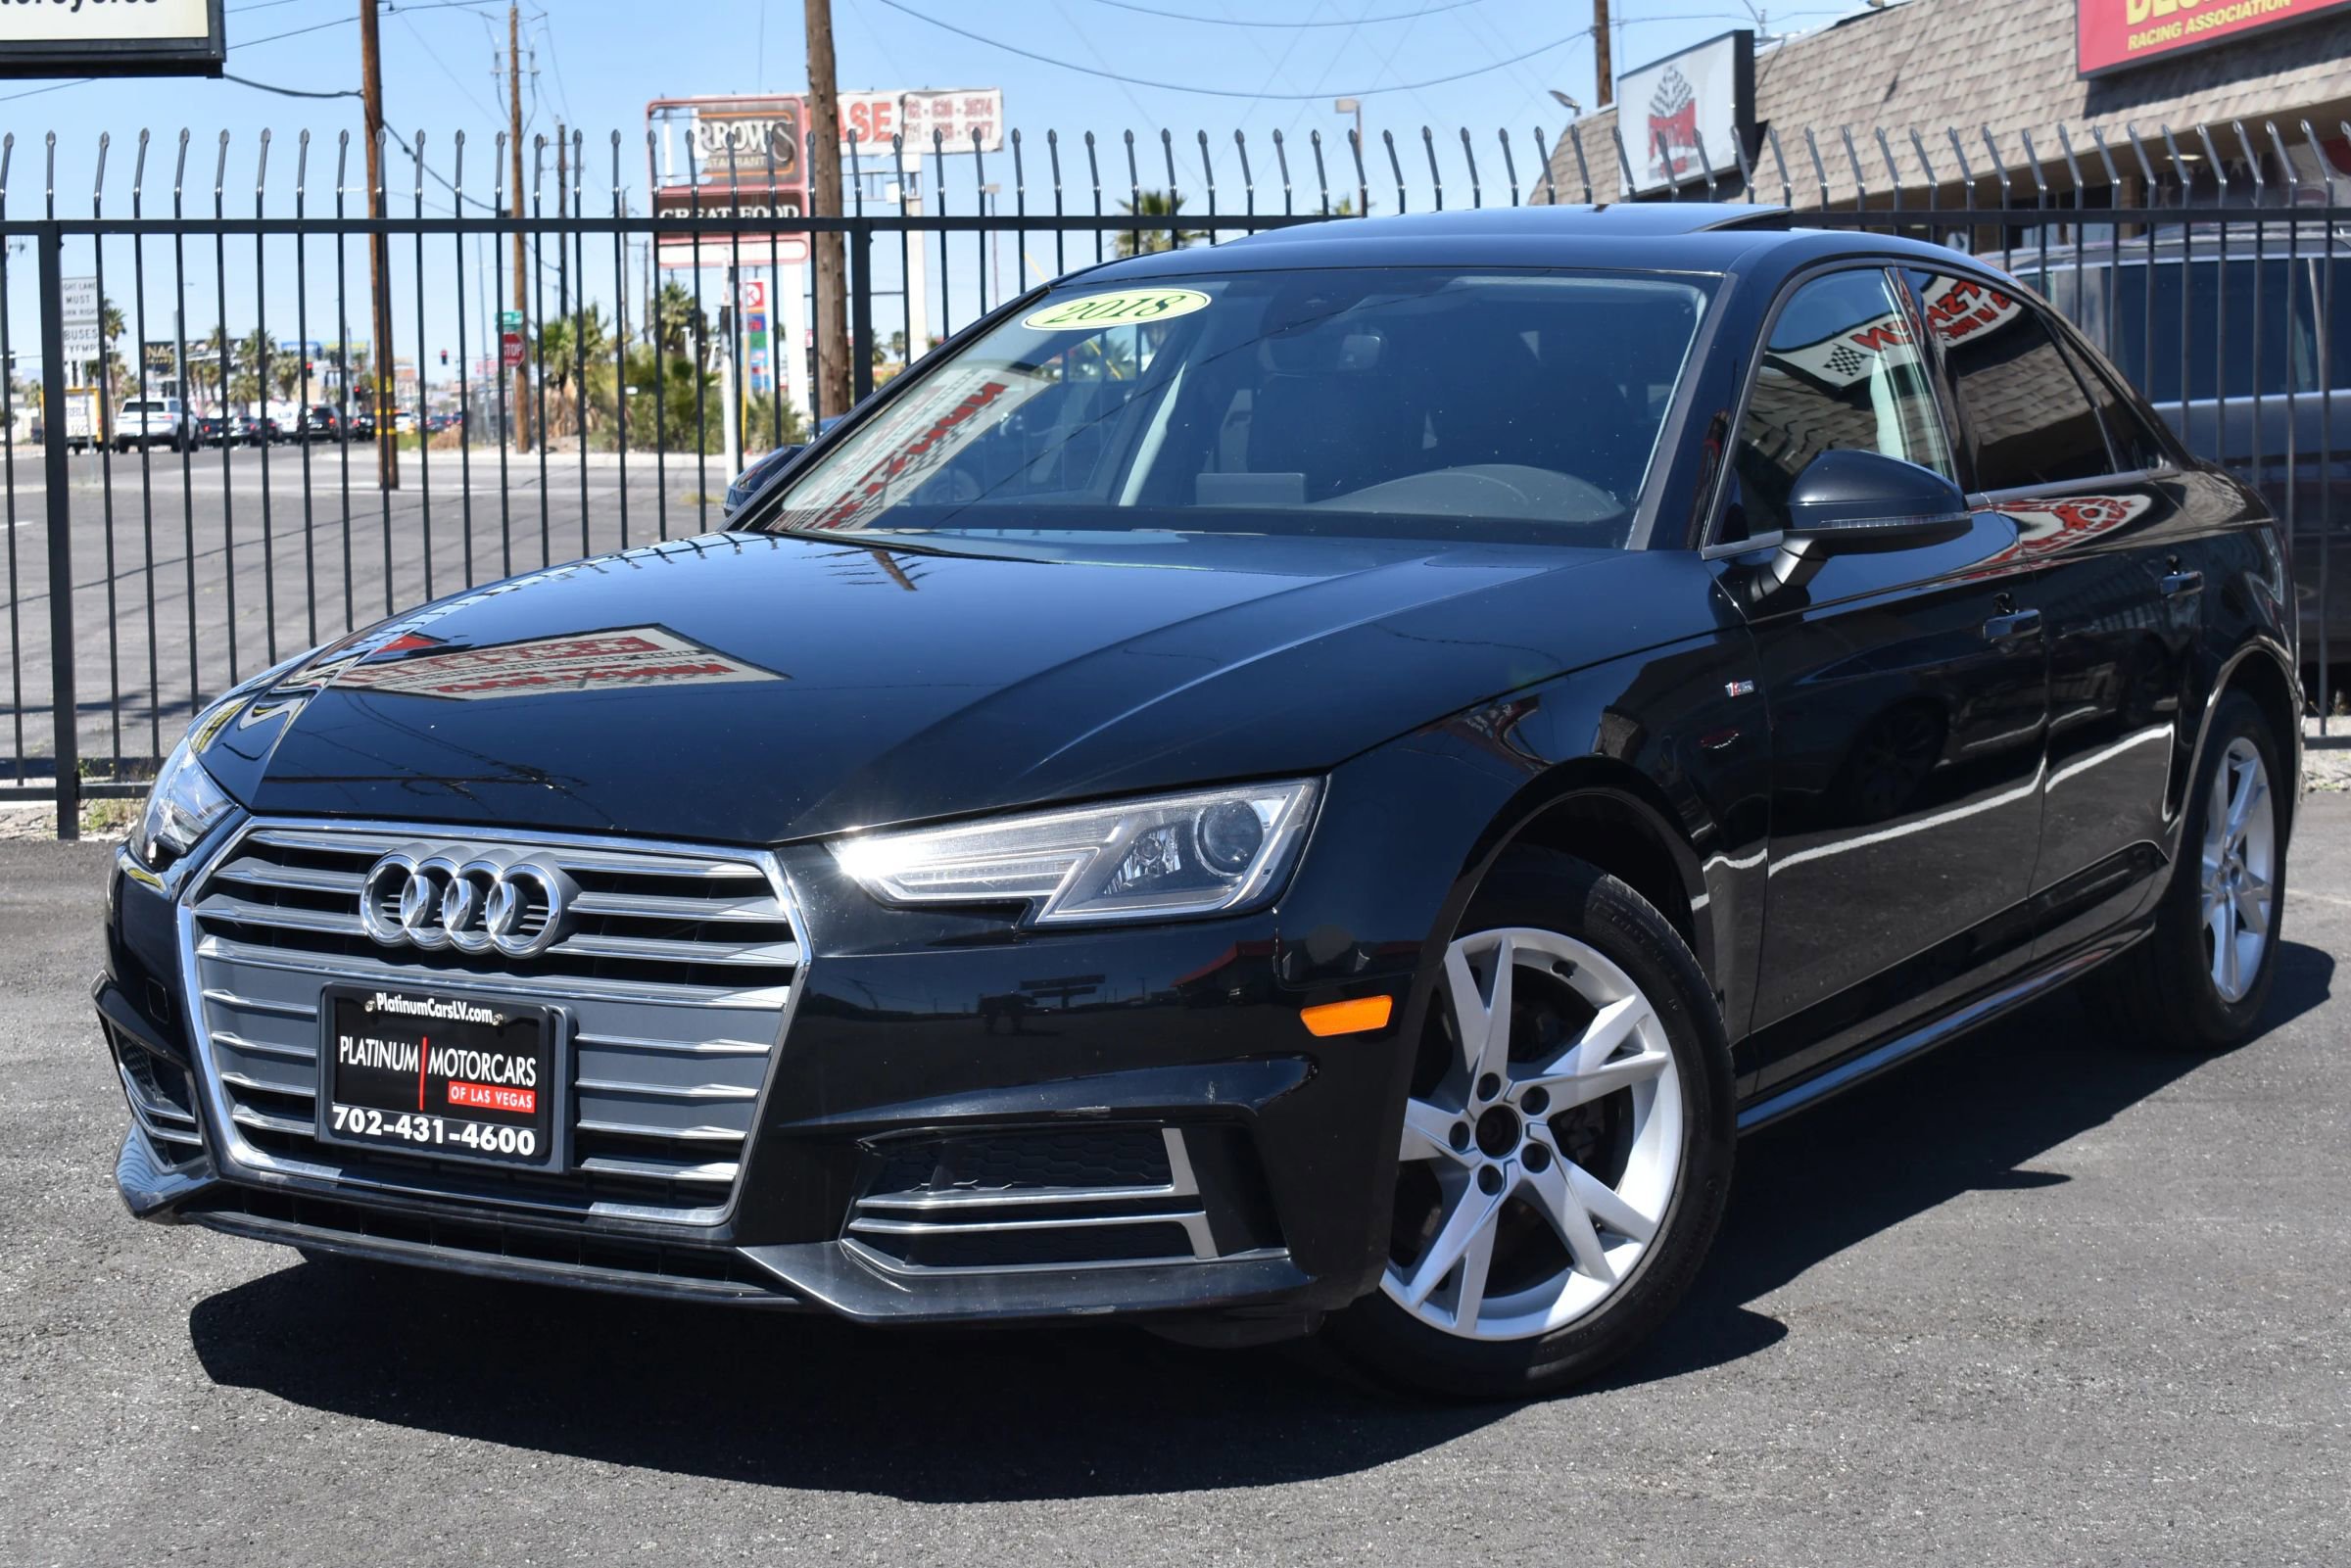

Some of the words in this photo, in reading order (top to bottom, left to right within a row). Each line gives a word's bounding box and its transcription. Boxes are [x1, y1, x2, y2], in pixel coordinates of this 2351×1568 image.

[2128, 22, 2183, 51] RACING
[2184, 0, 2291, 34] ASSOCIATION
[838, 101, 893, 142] ASE
[66, 295, 90, 305] MUST
[1042, 295, 1187, 324] 2018
[64, 329, 98, 340] BUSES
[376, 992, 493, 1022] PlatinumCarsLV.com
[340, 1035, 419, 1072] PLATINUM
[428, 1047, 537, 1087] MOTORCARS
[451, 1086, 466, 1100] OF
[470, 1089, 490, 1103] LAS
[496, 1091, 533, 1108] VEGAS
[332, 1106, 535, 1156] 702-431-4600
